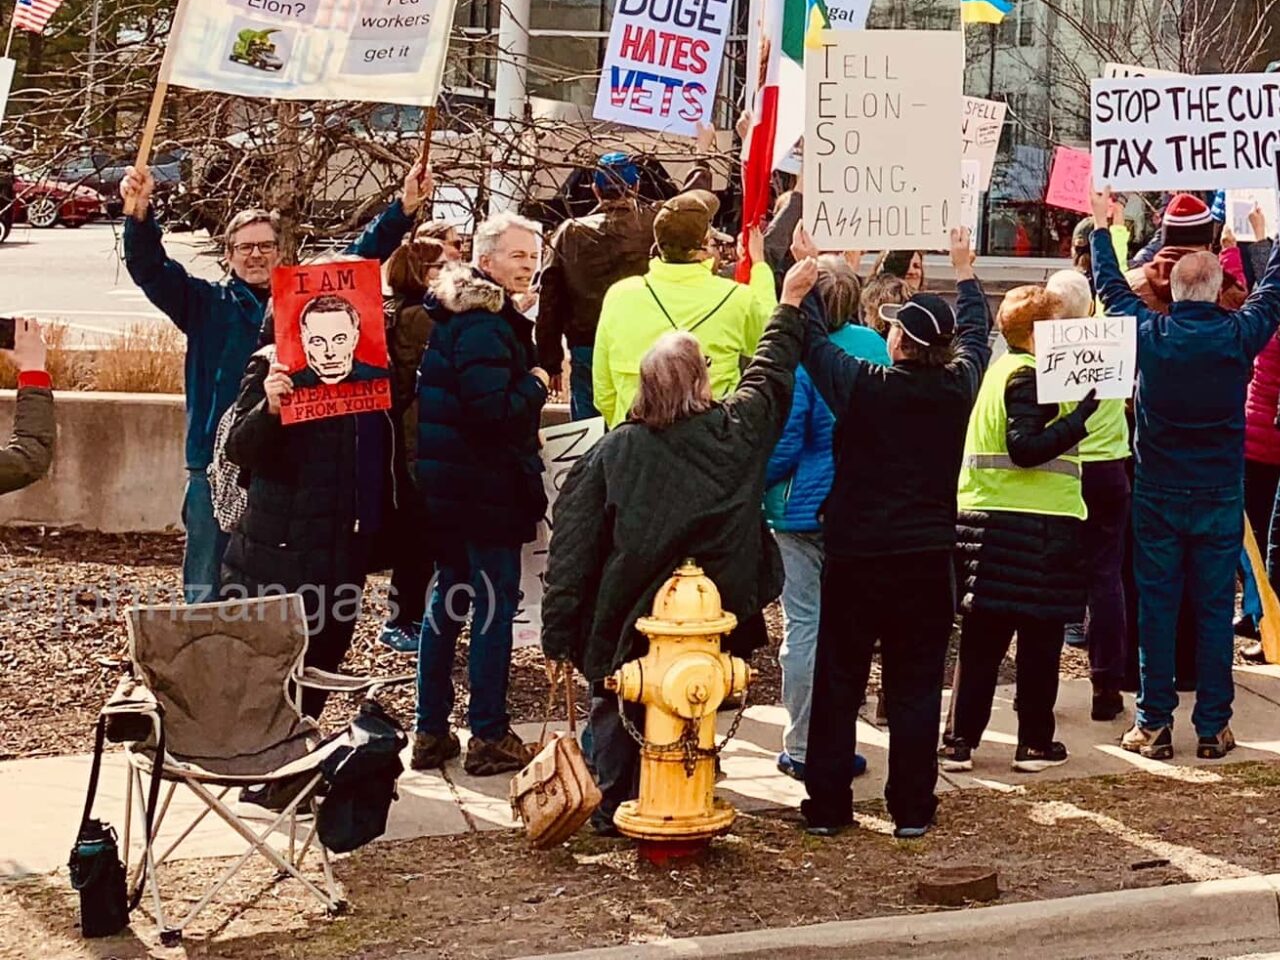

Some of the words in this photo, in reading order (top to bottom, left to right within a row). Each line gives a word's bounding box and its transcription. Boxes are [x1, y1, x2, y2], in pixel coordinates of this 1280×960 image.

[361, 13, 430, 28] workers
[364, 47, 395, 62] get
[398, 45, 410, 58] it
[620, 24, 710, 74] HATES
[822, 44, 898, 80] TELL
[611, 65, 707, 121] VETS
[1096, 89, 1160, 123] STOP
[1165, 86, 1224, 122] THE
[965, 101, 997, 120] SPELL
[816, 122, 860, 155] SO
[1096, 138, 1158, 179] TAX
[1165, 132, 1227, 172] THE
[294, 273, 309, 294] I
[320, 269, 355, 292] AM
[1052, 320, 1124, 343] HONK!
[1043, 352, 1067, 373] IF
[1073, 349, 1104, 365] YOU
[1065, 360, 1123, 386] AGREE!
[279, 380, 388, 407] STEALING
[294, 402, 338, 421] FROM
